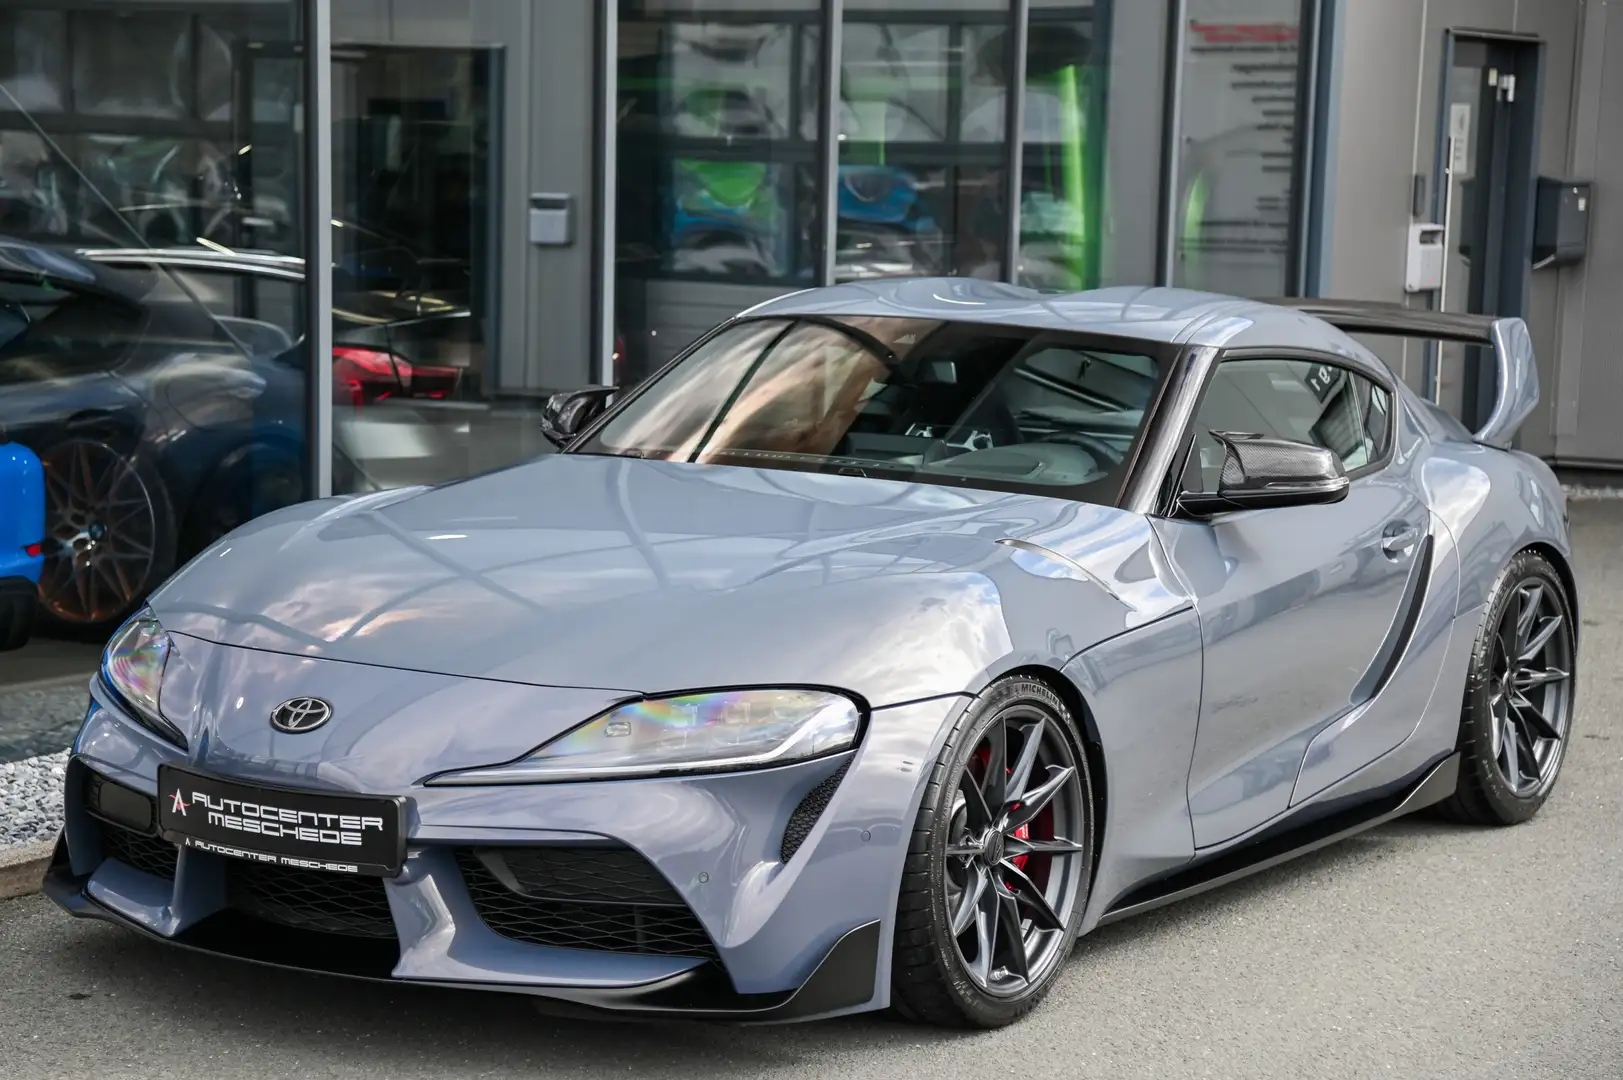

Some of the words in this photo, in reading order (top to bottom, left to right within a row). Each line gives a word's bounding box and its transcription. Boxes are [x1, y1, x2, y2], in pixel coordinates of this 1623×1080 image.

[1021, 683, 1059, 708] MICHELIN
[191, 791, 383, 831] AUTOCENTER
[208, 811, 362, 846] MESCHEDE
[194, 840, 277, 863] AUTOCENTER
[280, 857, 358, 873] MESCHEDE
